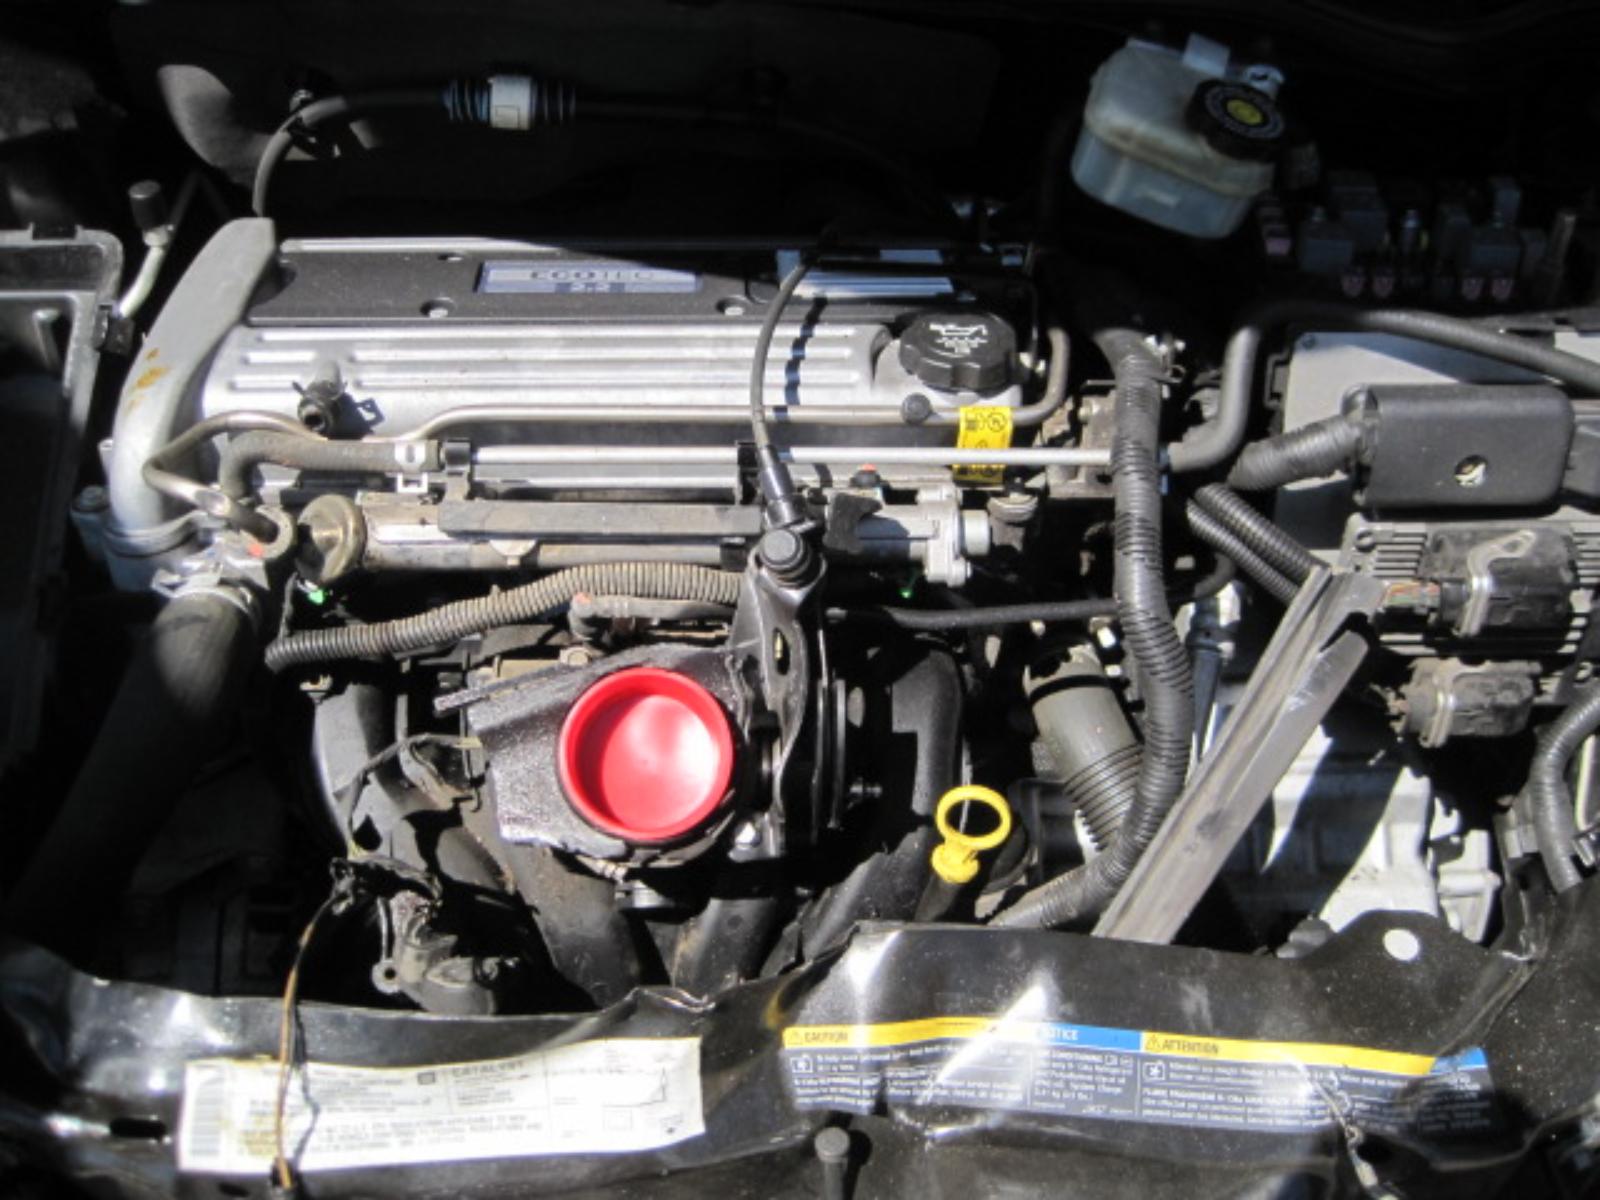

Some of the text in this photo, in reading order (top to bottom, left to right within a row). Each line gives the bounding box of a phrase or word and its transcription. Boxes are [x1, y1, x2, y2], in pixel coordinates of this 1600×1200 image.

[530, 271, 653, 280] ECOTEC
[804, 1032, 849, 1043] CAUTION
[1162, 1039, 1219, 1054] ATTENTION
